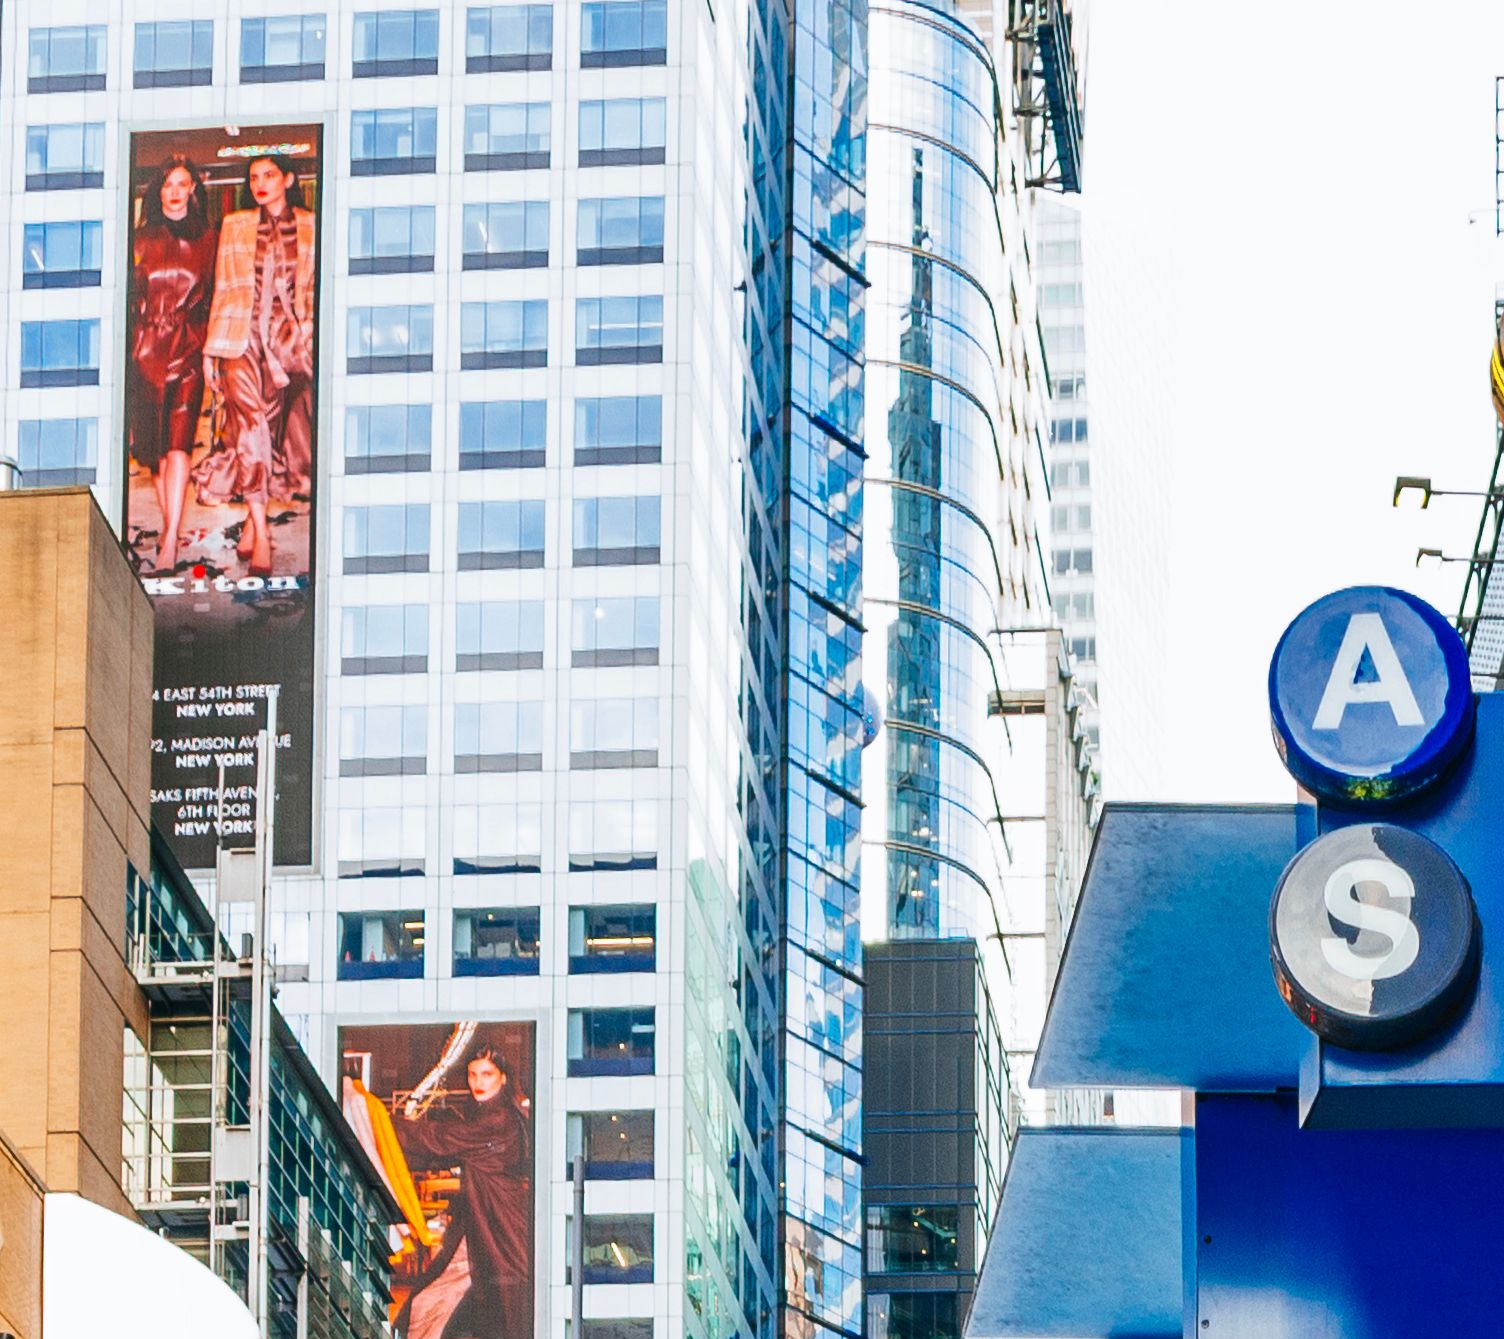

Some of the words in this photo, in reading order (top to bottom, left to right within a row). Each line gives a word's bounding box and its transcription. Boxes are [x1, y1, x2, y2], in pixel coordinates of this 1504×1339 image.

[142, 566, 301, 595] Kiton
[1311, 614, 1425, 730] A
[163, 687, 195, 701] EAST
[199, 686, 232, 700] 54TH
[235, 684, 281, 698] STREET
[176, 704, 210, 718] NEW
[215, 702, 255, 717] YORK
[171, 736, 235, 751] MADISON
[175, 755, 211, 769] NEW
[213, 752, 254, 767] YORK
[184, 787, 218, 801] FIFTH
[177, 805, 203, 820] 6TH
[207, 804, 250, 818] FLOOR
[174, 822, 210, 836] NEW
[213, 820, 254, 836] YORK
[1320, 856, 1422, 980] S
